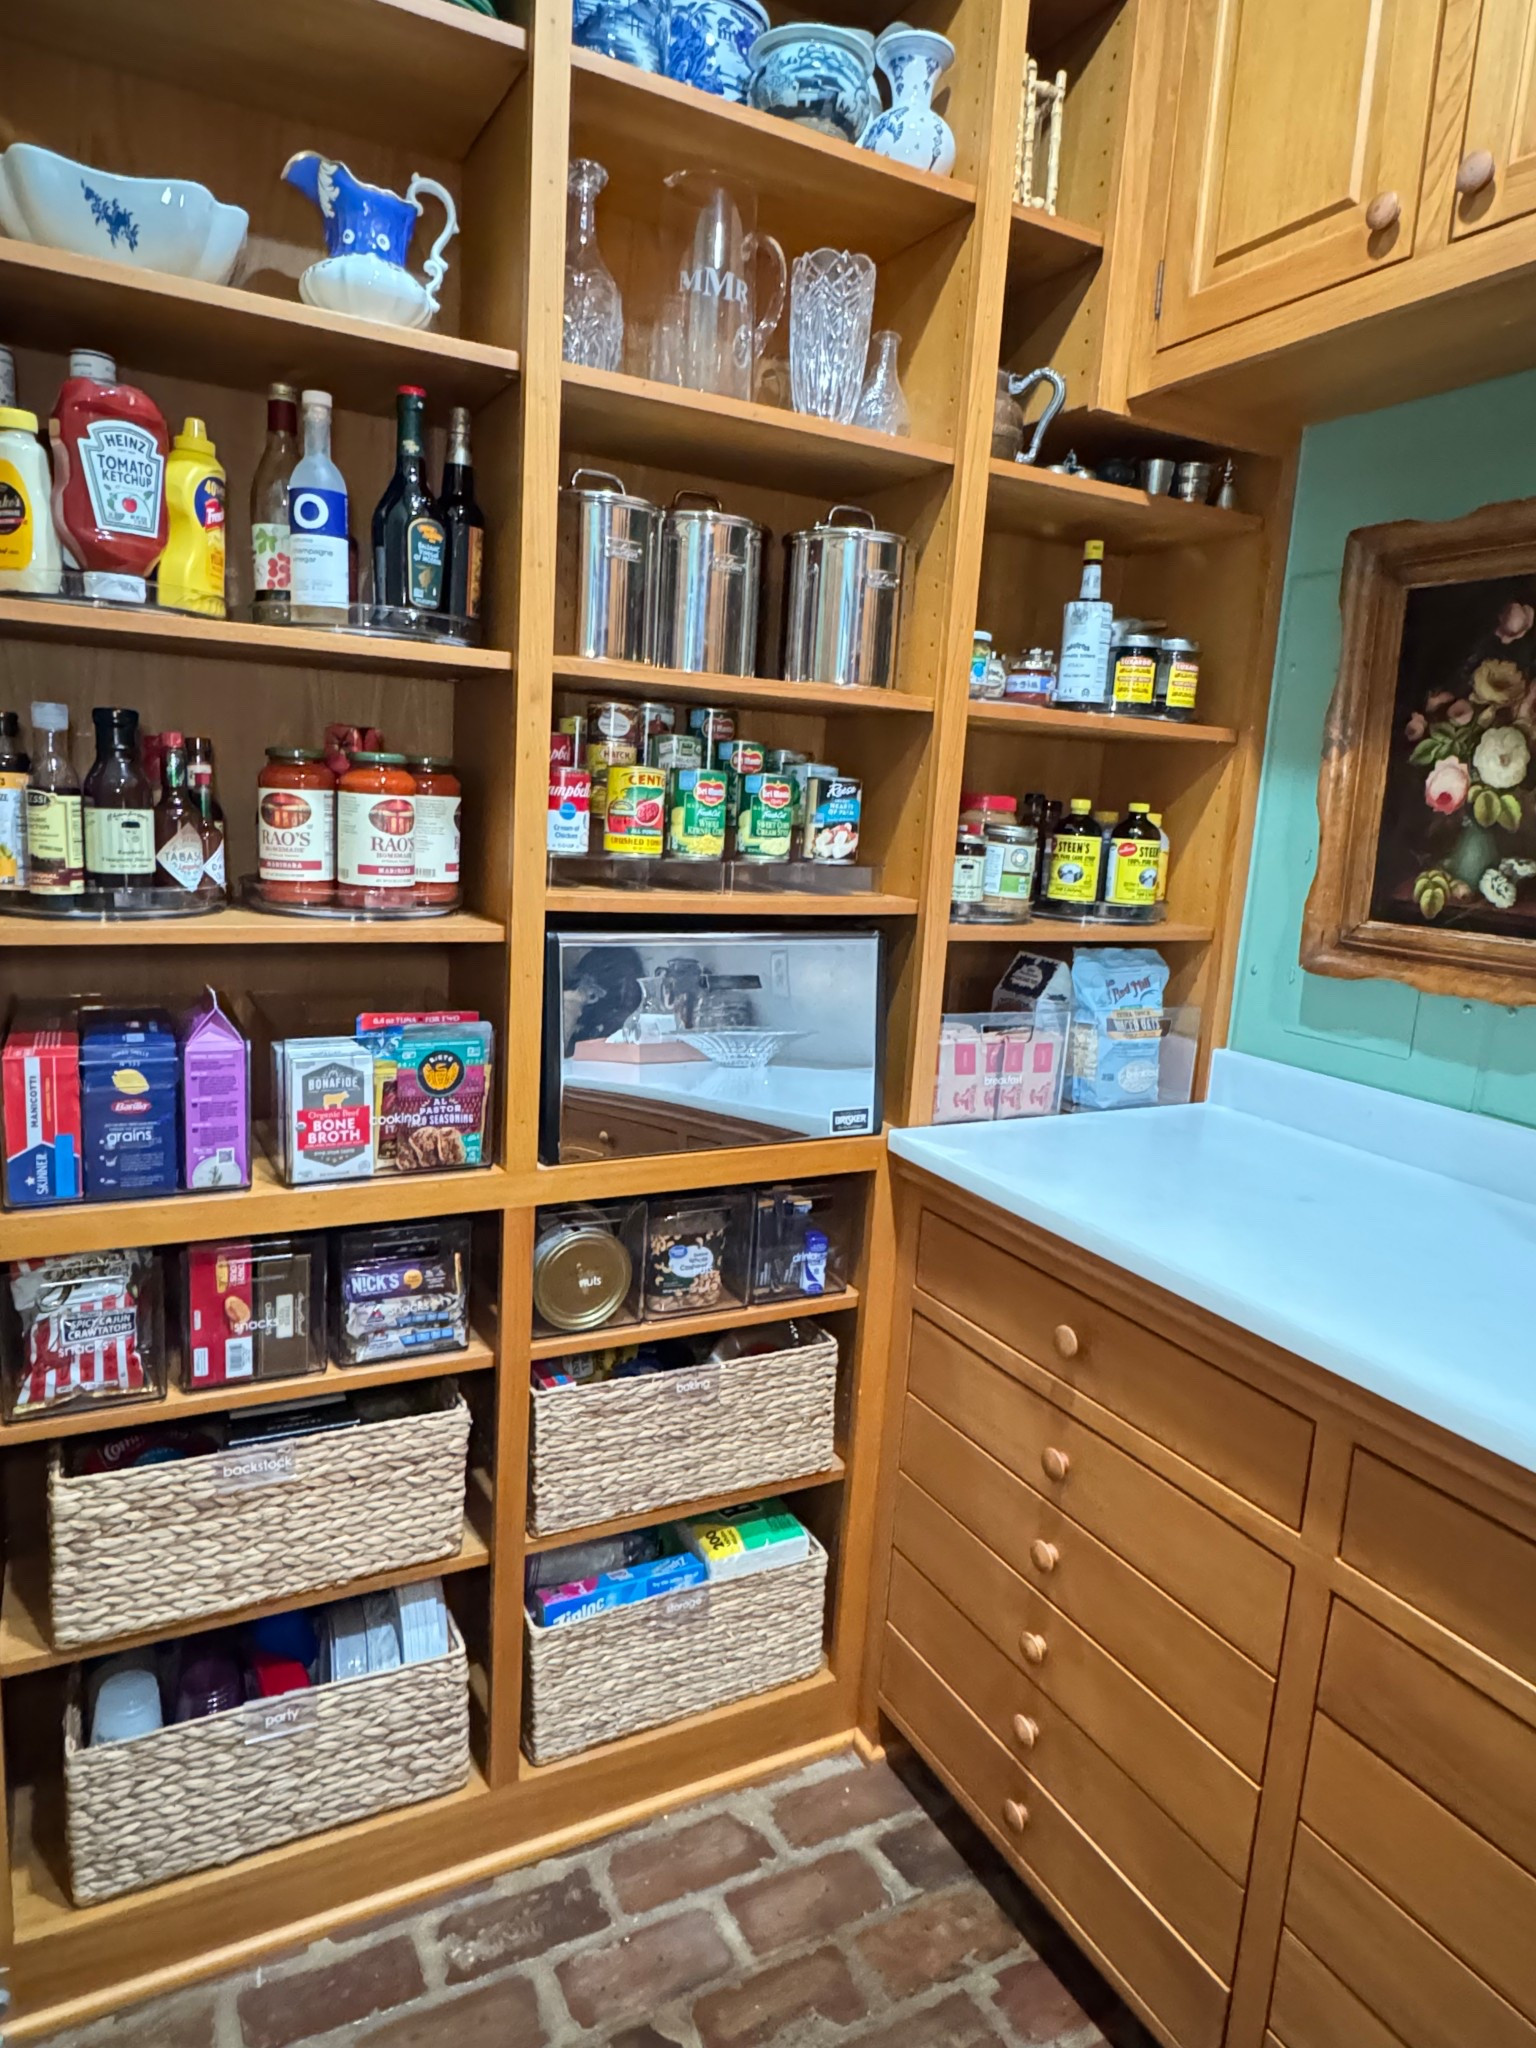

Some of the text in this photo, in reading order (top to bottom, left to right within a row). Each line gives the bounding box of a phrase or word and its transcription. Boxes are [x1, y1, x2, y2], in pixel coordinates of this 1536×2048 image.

[104, 434, 146, 454] HEINZ
[97, 454, 153, 478] TOMATO
[103, 470, 152, 488] KETCHUP
[262, 829, 311, 847] RAO'S
[1058, 841, 1090, 854] STEEN'S
[308, 1076, 358, 1091] BONAFIDE
[984, 1075, 1022, 1086] breakfast
[29, 1076, 38, 1128] MANICOTTI
[115, 1101, 151, 1112] Barilla
[420, 1104, 461, 1115] PASTOR
[308, 1107, 360, 1121] Organic Beef
[371, 1112, 421, 1127] cooking
[429, 1114, 473, 1125] SEASONING
[313, 1117, 355, 1132] BONE
[106, 1128, 152, 1150] grains
[308, 1129, 361, 1145] BROTH
[35, 1153, 49, 1194] SKINNER
[99, 1314, 131, 1325] CAJUN
[68, 1322, 132, 1340] CRAWTATORS
[58, 1341, 110, 1358] snacks
[223, 1456, 292, 1478] backstock
[265, 1707, 300, 1728] party
